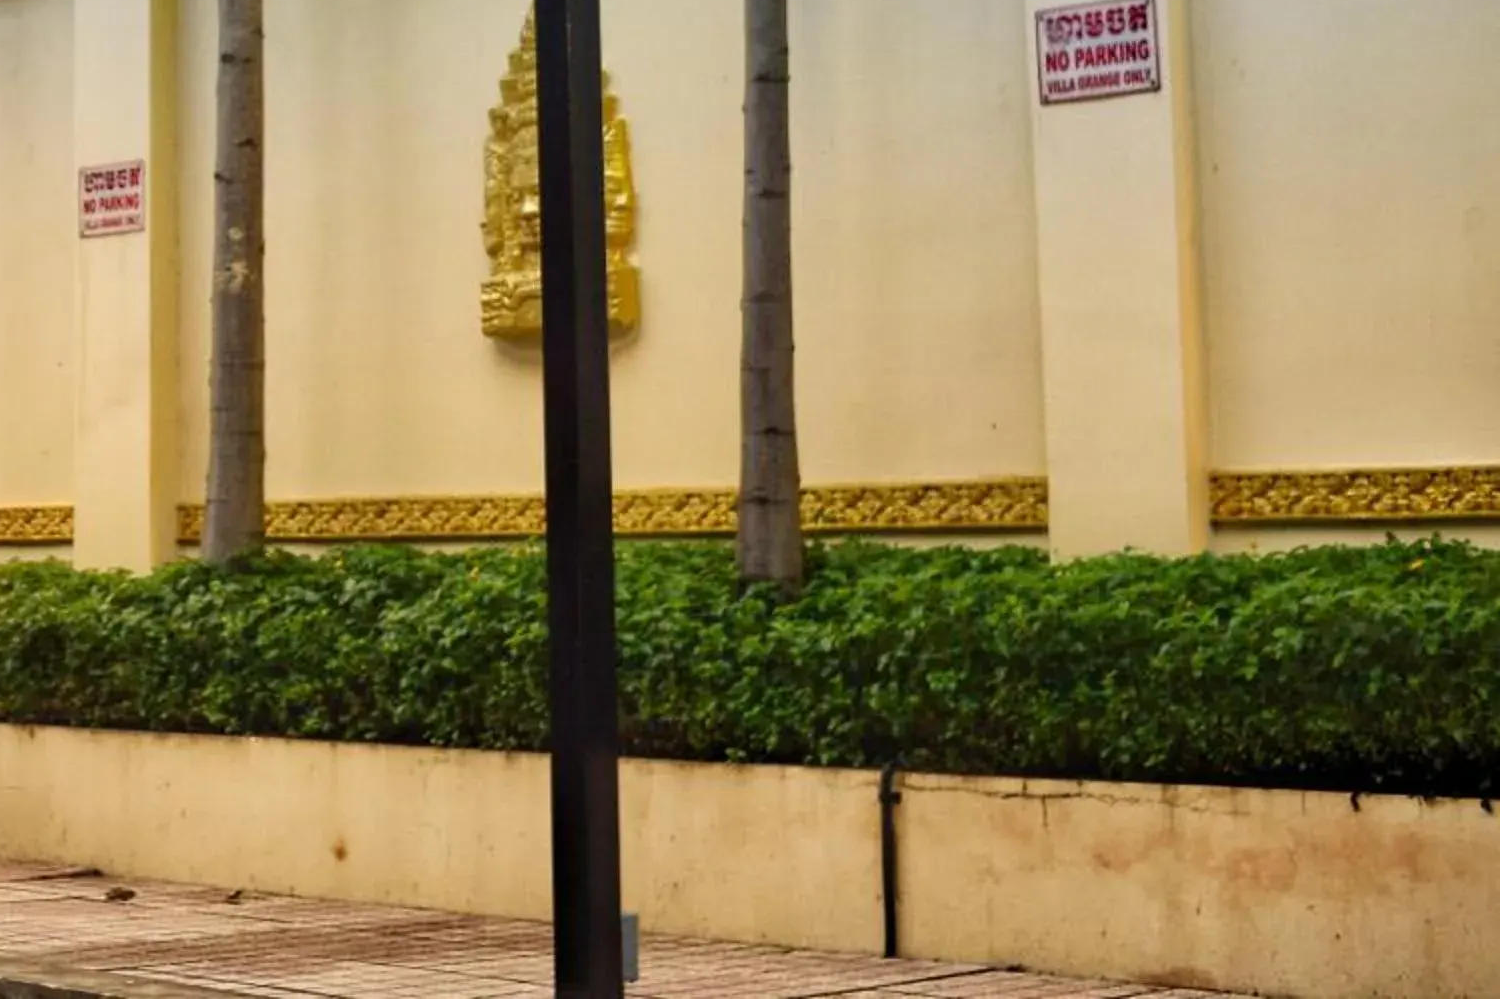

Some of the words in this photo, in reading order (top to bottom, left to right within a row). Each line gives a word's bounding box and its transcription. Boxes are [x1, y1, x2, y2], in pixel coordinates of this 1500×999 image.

[1045, 50, 1069, 72] NO
[1075, 39, 1150, 69] PARKING
[1046, 78, 1076, 93] VILLA
[1078, 71, 1121, 90] GRANGE
[1123, 68, 1151, 86] ONLY
[83, 199, 96, 214] NO
[100, 192, 139, 211] PARKING
